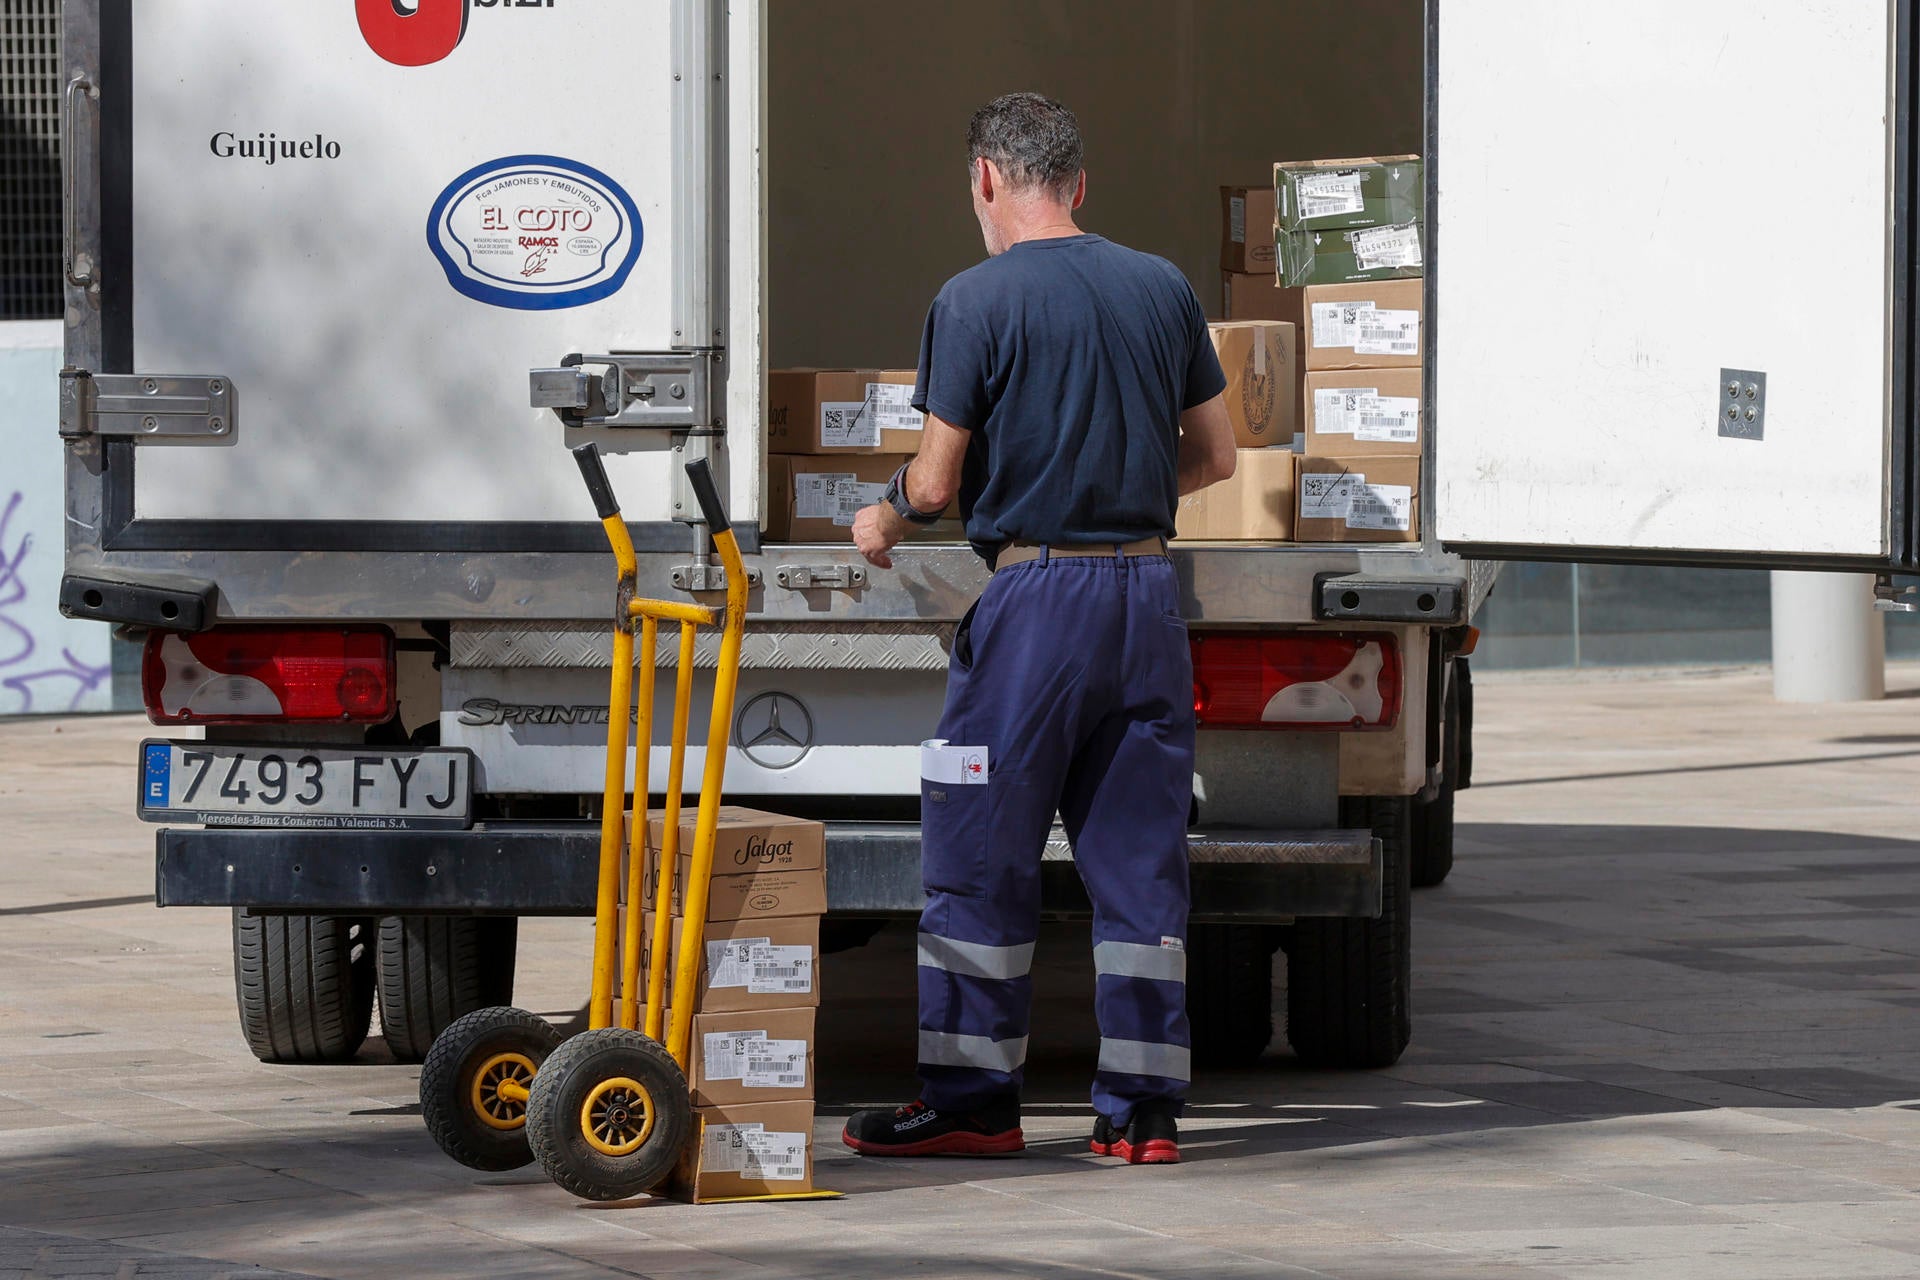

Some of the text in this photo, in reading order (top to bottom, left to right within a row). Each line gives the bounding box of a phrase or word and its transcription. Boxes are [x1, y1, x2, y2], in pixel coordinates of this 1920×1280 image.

[210, 131, 341, 165] Guijuelo
[475, 177, 601, 213] Fca JAMONES Y EMBUTIDOS
[480, 205, 593, 232] EL COTO
[518, 236, 559, 250] RAMOS
[150, 783, 163, 796] E
[182, 752, 456, 809] 7493 FYJ
[197, 813, 410, 829] Mercedes-Benz Comercial Valencia S.A.
[734, 834, 794, 866] Salgot
[893, 1109, 937, 1131] sparco
